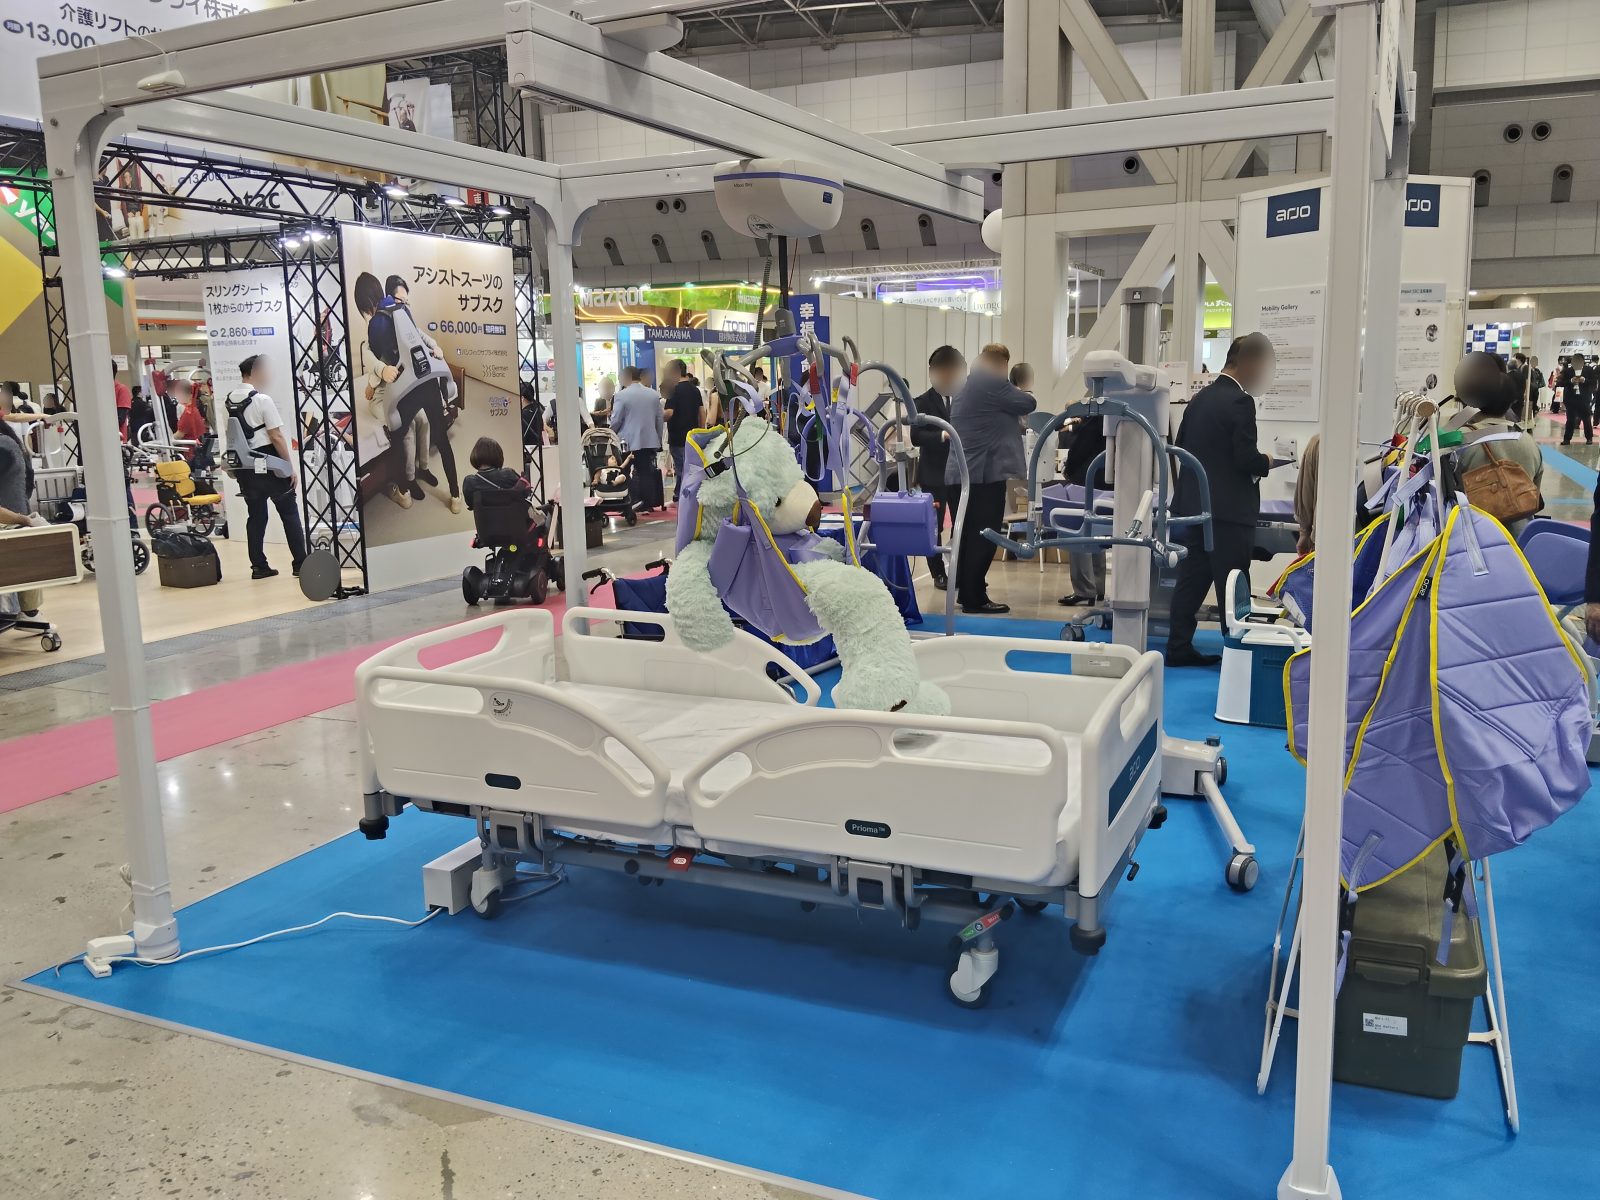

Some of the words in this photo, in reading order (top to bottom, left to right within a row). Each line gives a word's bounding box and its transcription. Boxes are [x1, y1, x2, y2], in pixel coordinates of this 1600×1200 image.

[413, 266, 503, 289] アシストスーツの
[206, 283, 269, 298] スリングシート
[208, 300, 283, 315] 1枚からのサブスク
[458, 293, 503, 313] サブスク
[1281, 303, 1298, 311] Gallery
